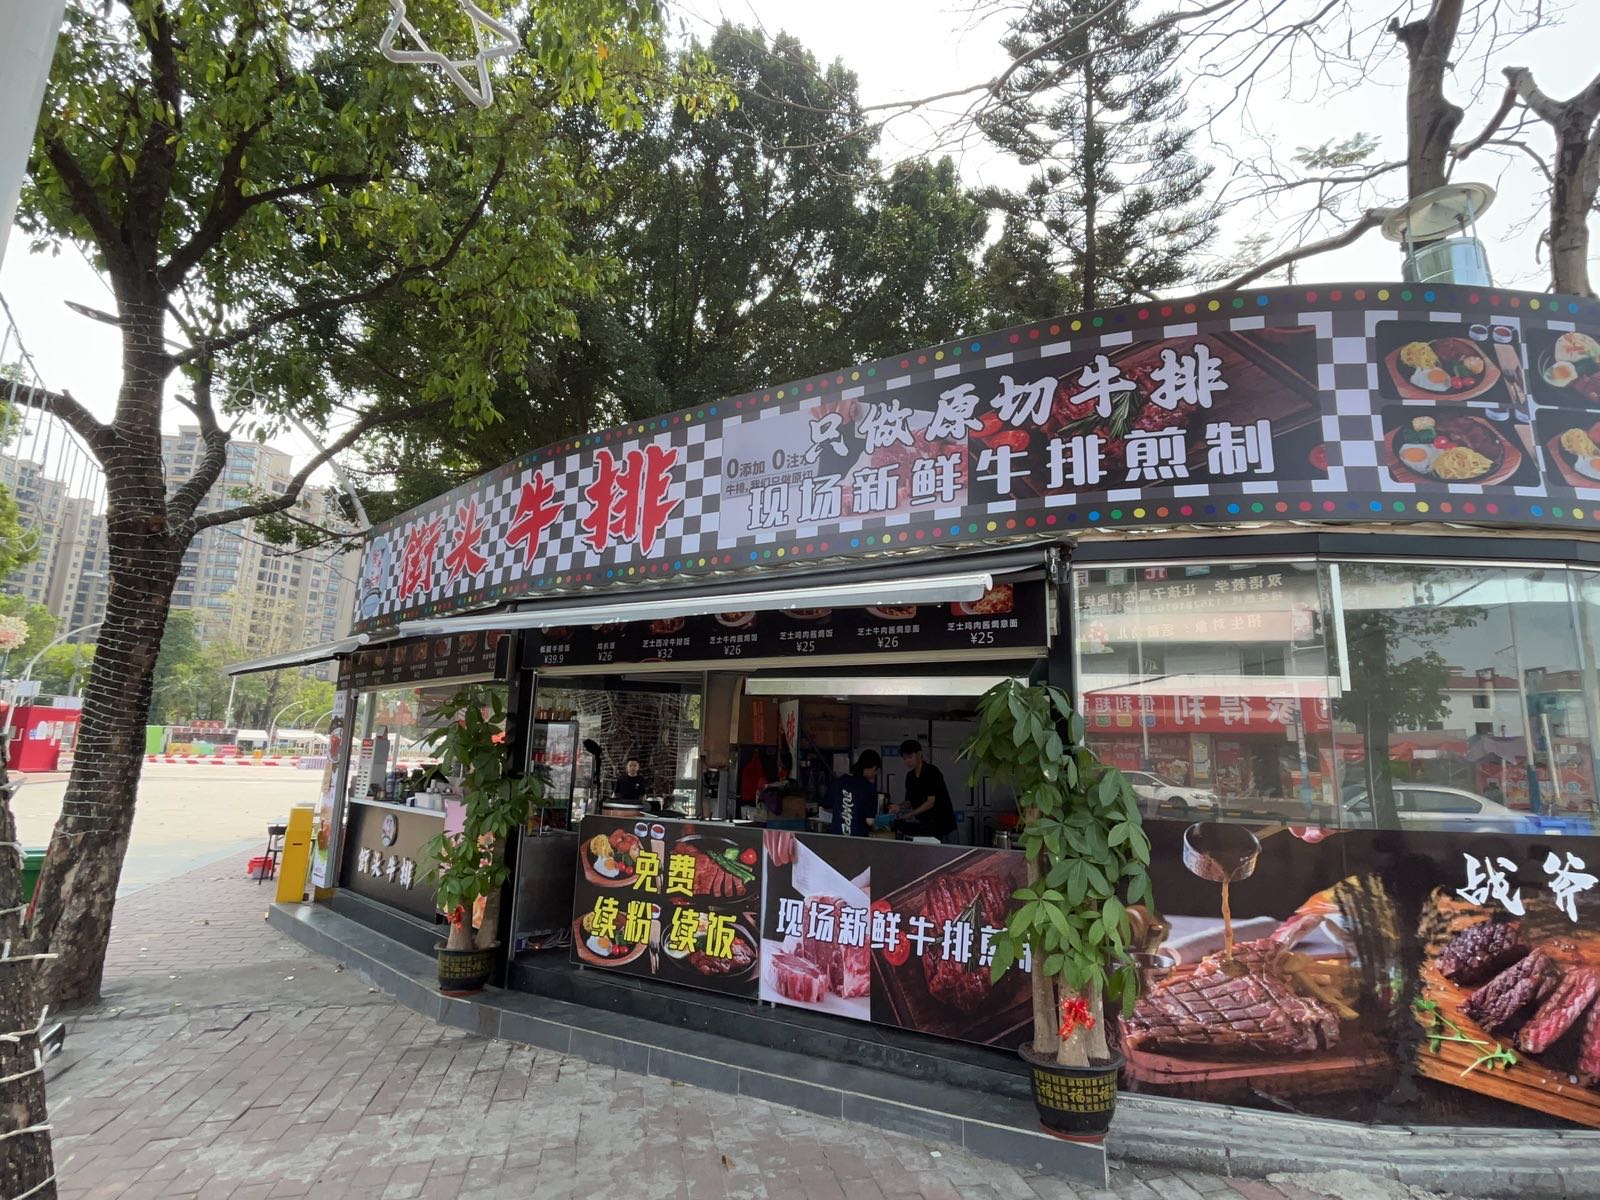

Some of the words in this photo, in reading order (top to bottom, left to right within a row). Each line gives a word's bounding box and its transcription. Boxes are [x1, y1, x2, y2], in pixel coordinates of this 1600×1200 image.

[804, 345, 1228, 464] 只做原切牛排
[727, 458, 766, 479] 0添加
[748, 419, 1275, 530] 现场新鲜牛排煎制
[400, 443, 682, 601] 街头牛排
[796, 641, 815, 652] ¥25
[877, 636, 899, 648] ¥26
[970, 632, 994, 645] ¥25
[657, 648, 673, 659] ¥32
[724, 645, 742, 656] ¥26
[632, 850, 698, 898] 免费
[589, 896, 653, 945] 续粉
[669, 906, 738, 960] 续饭
